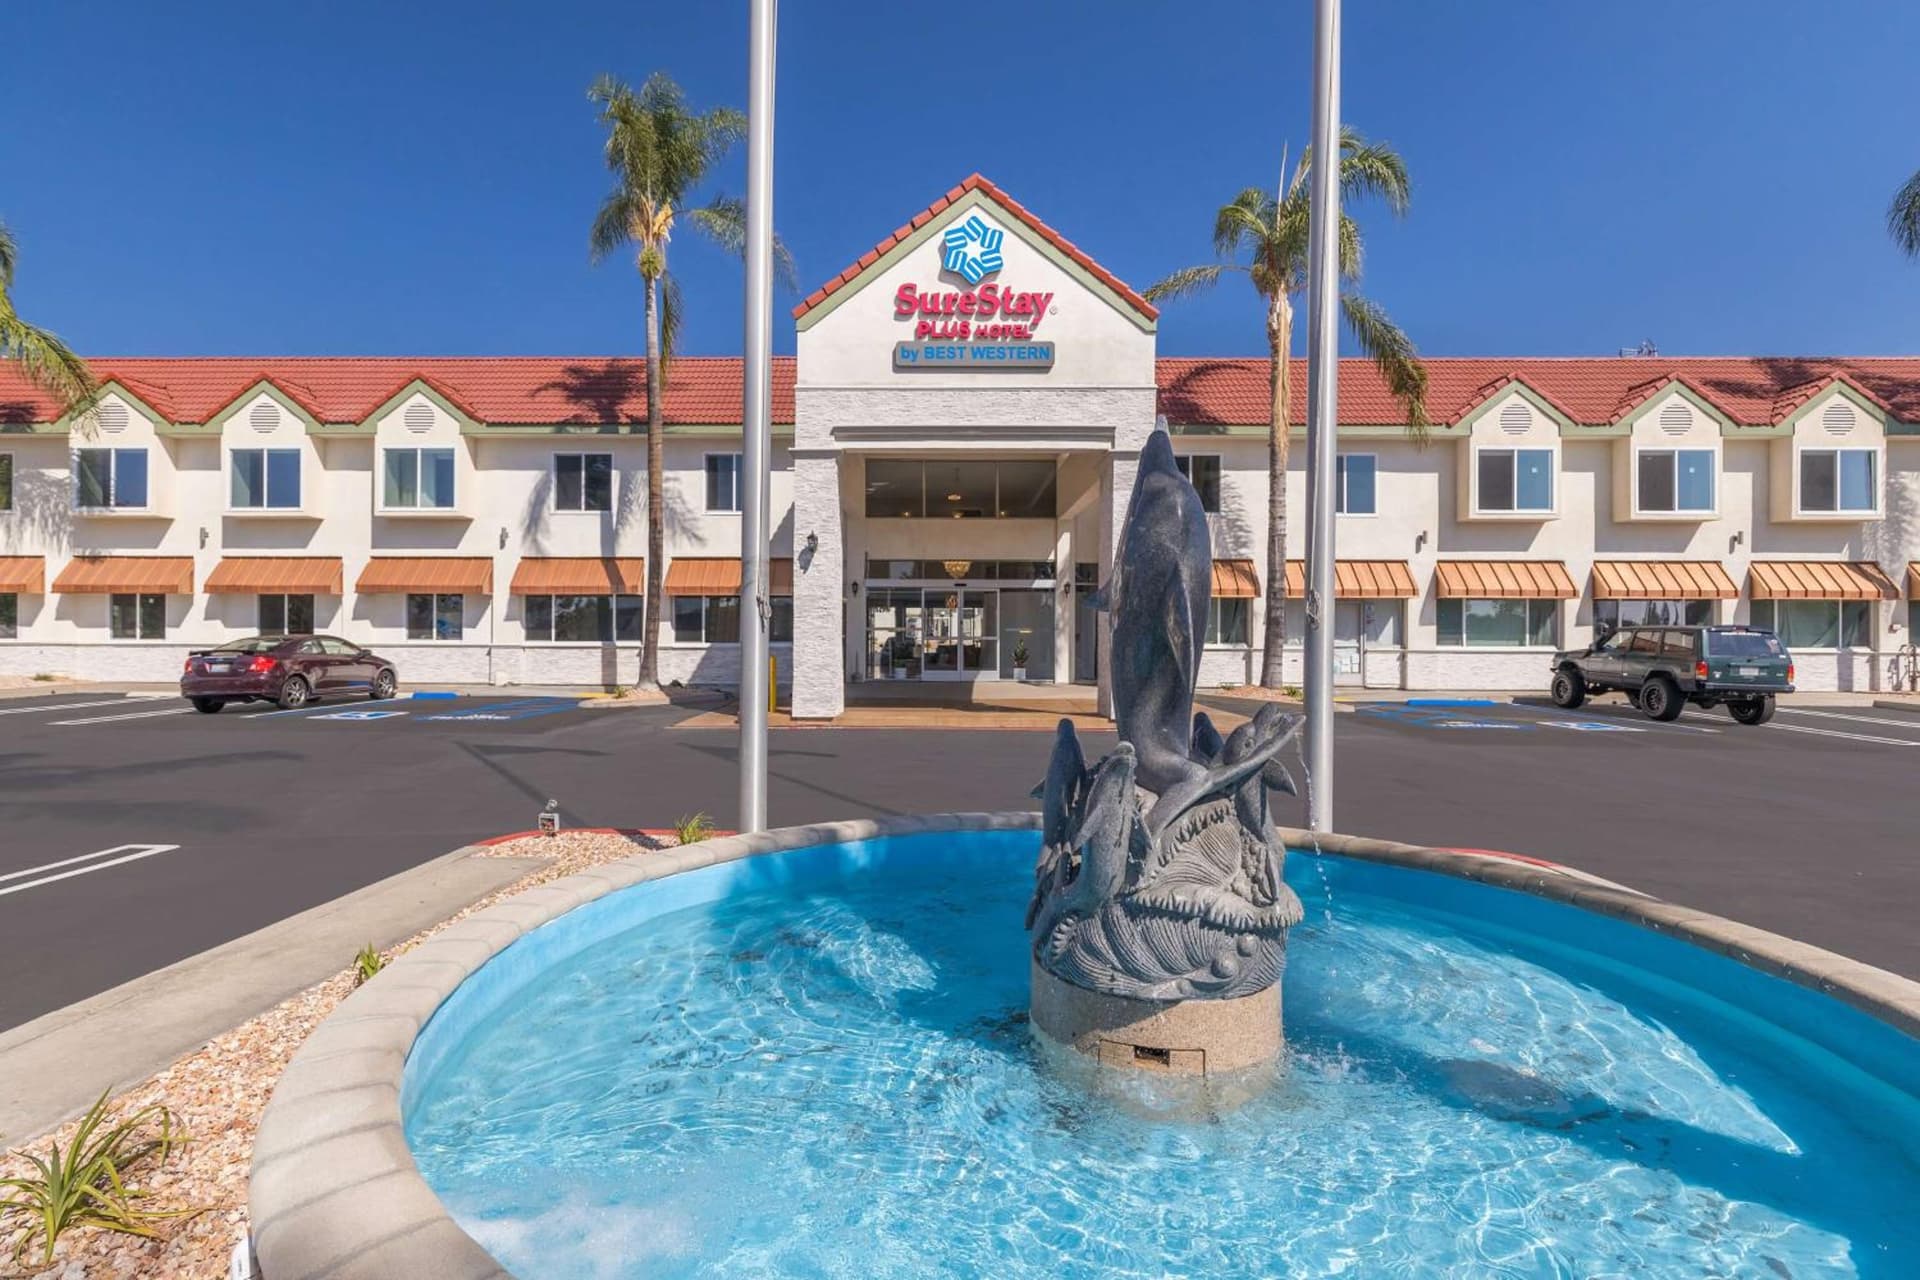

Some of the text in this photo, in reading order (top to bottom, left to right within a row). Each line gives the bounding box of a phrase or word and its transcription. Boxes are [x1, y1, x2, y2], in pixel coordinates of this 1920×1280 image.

[896, 283, 1054, 326] SureStay
[916, 321, 1033, 339] PLUS HOTEL
[901, 346, 1050, 361] by BEST WESTERN
